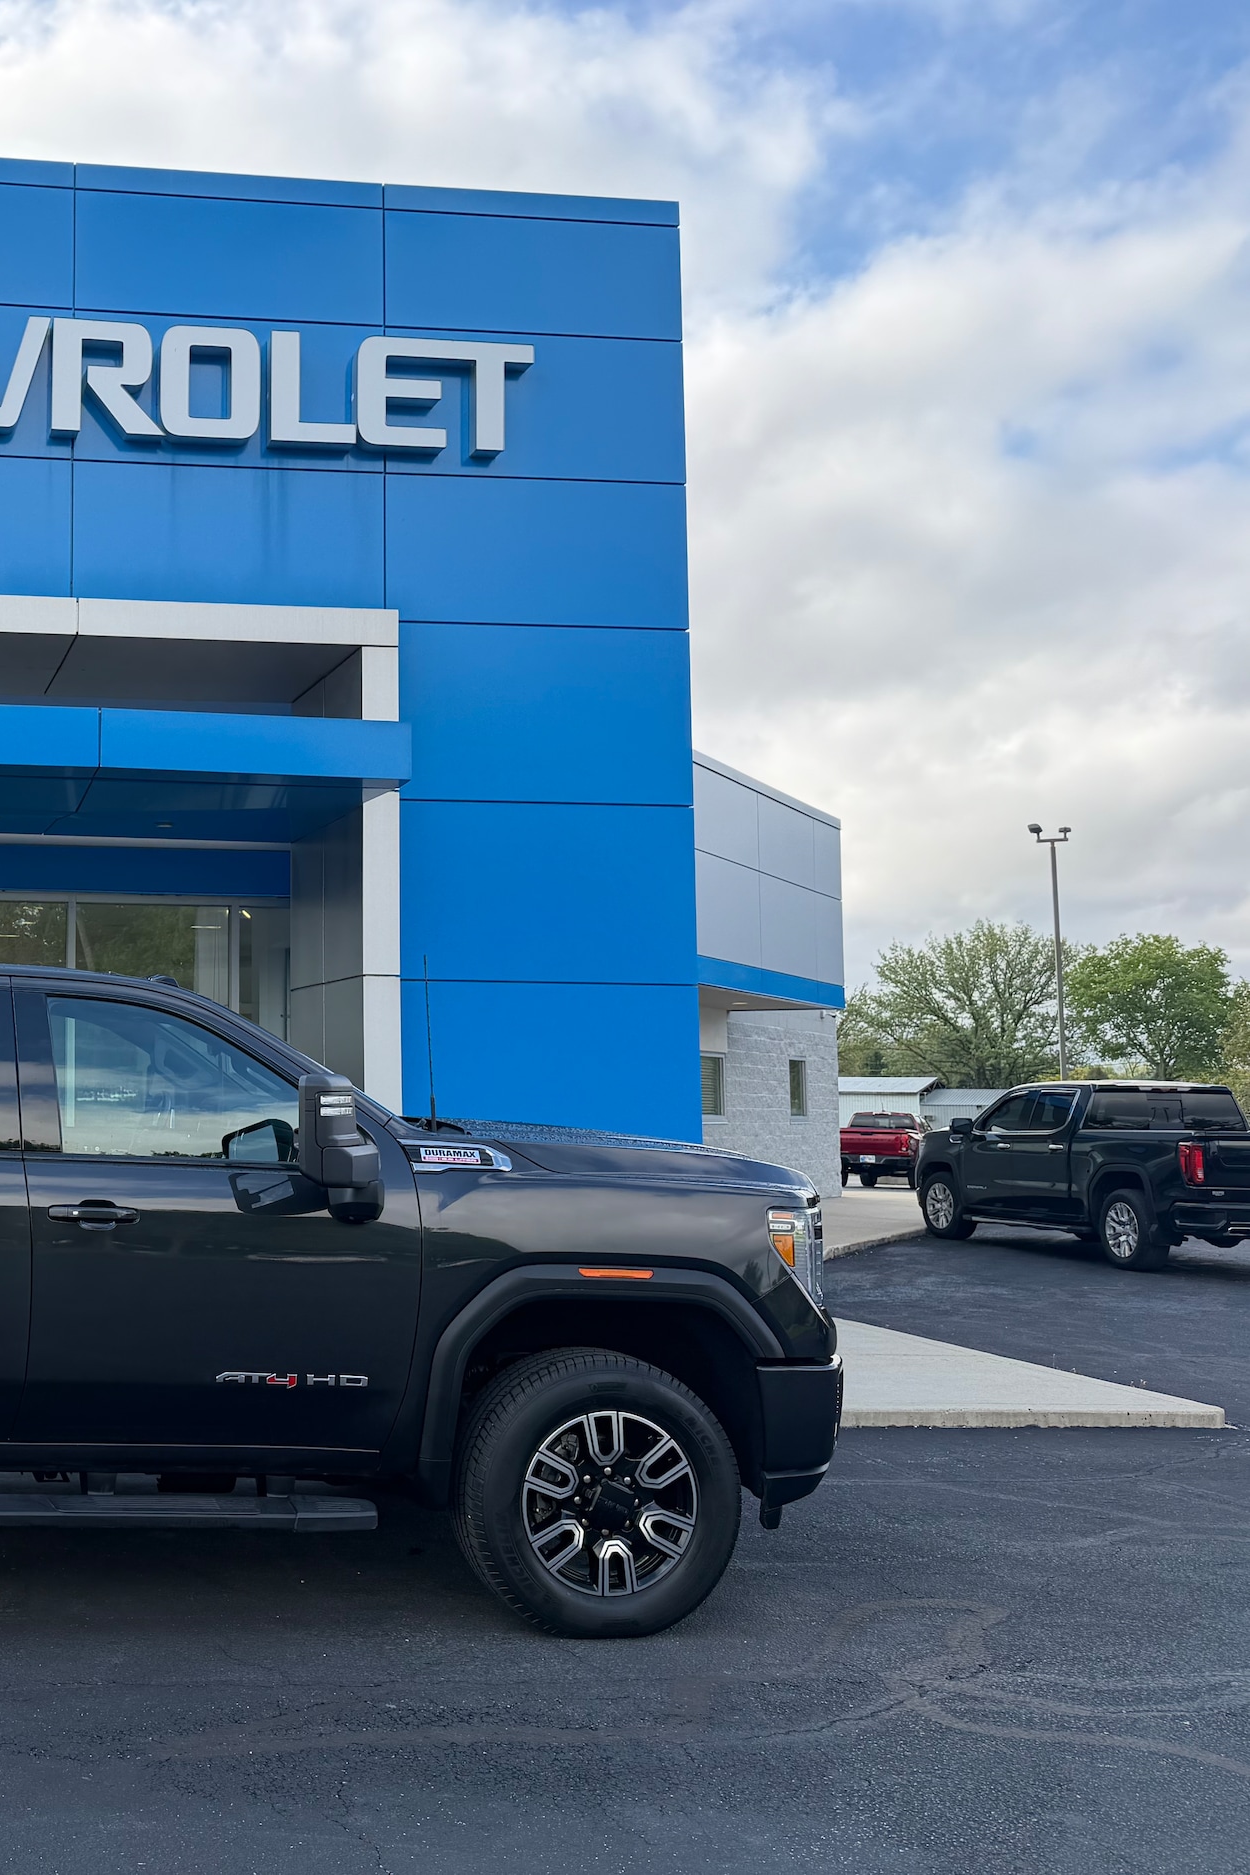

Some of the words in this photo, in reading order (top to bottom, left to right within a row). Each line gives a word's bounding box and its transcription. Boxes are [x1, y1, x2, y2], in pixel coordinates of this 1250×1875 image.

[424, 1148, 476, 1158] DURAMAX
[215, 1370, 298, 1389] AT4
[306, 1373, 369, 1387] HD
